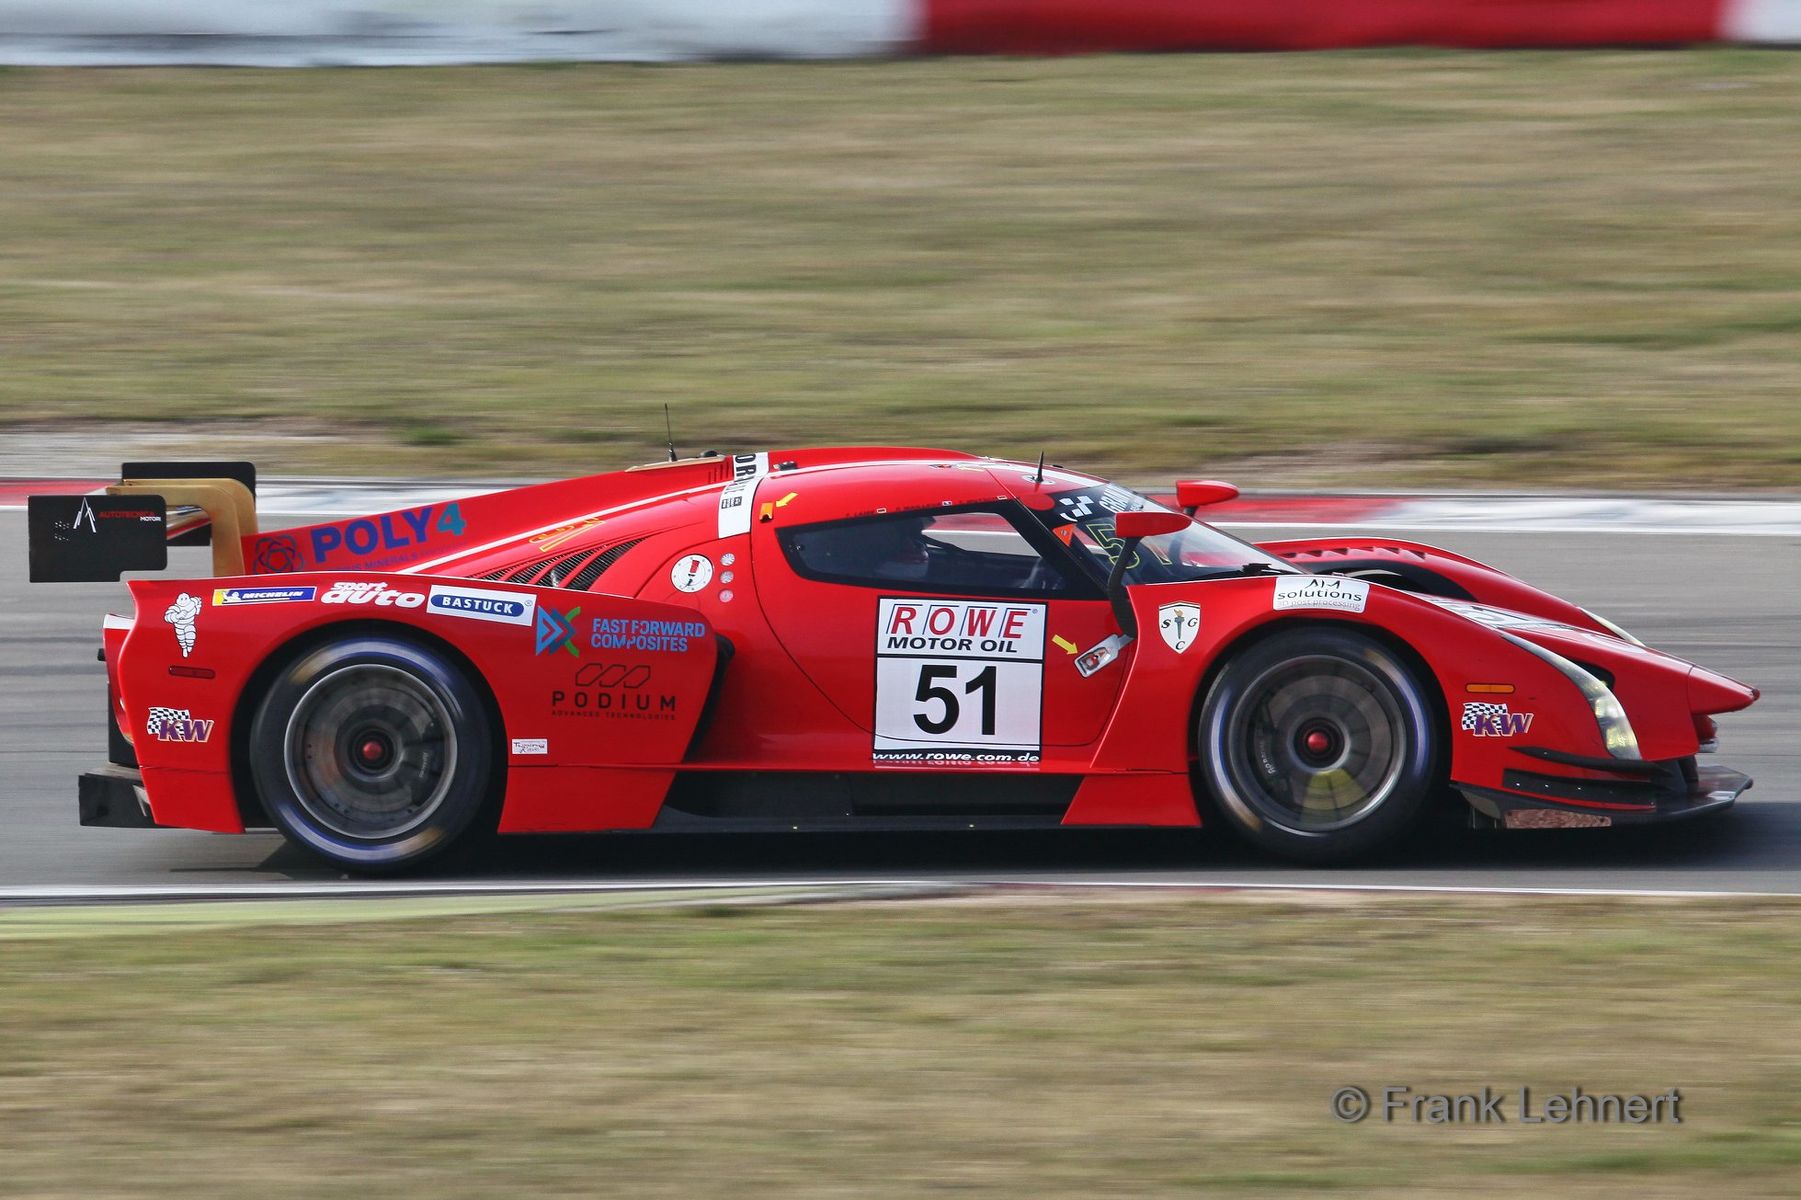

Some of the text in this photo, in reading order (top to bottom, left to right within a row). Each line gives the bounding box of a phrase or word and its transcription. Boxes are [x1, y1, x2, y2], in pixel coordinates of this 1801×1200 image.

[242, 591, 304, 600] MICHELIN
[330, 581, 388, 592] sport
[1277, 589, 1363, 601] solutions
[320, 589, 426, 608] auto
[442, 596, 514, 614] BASTUCK
[593, 618, 706, 637] FAST FORWARD
[888, 605, 1029, 639] ROWE
[591, 632, 688, 652] COMPOSITES
[887, 636, 1018, 653] MOTOR OIL
[552, 690, 676, 711] PODIUM
[913, 664, 997, 736] 51
[158, 719, 215, 743] KW
[1473, 712, 1534, 737] KW
[872, 752, 1040, 762] www.rowe.com.de
